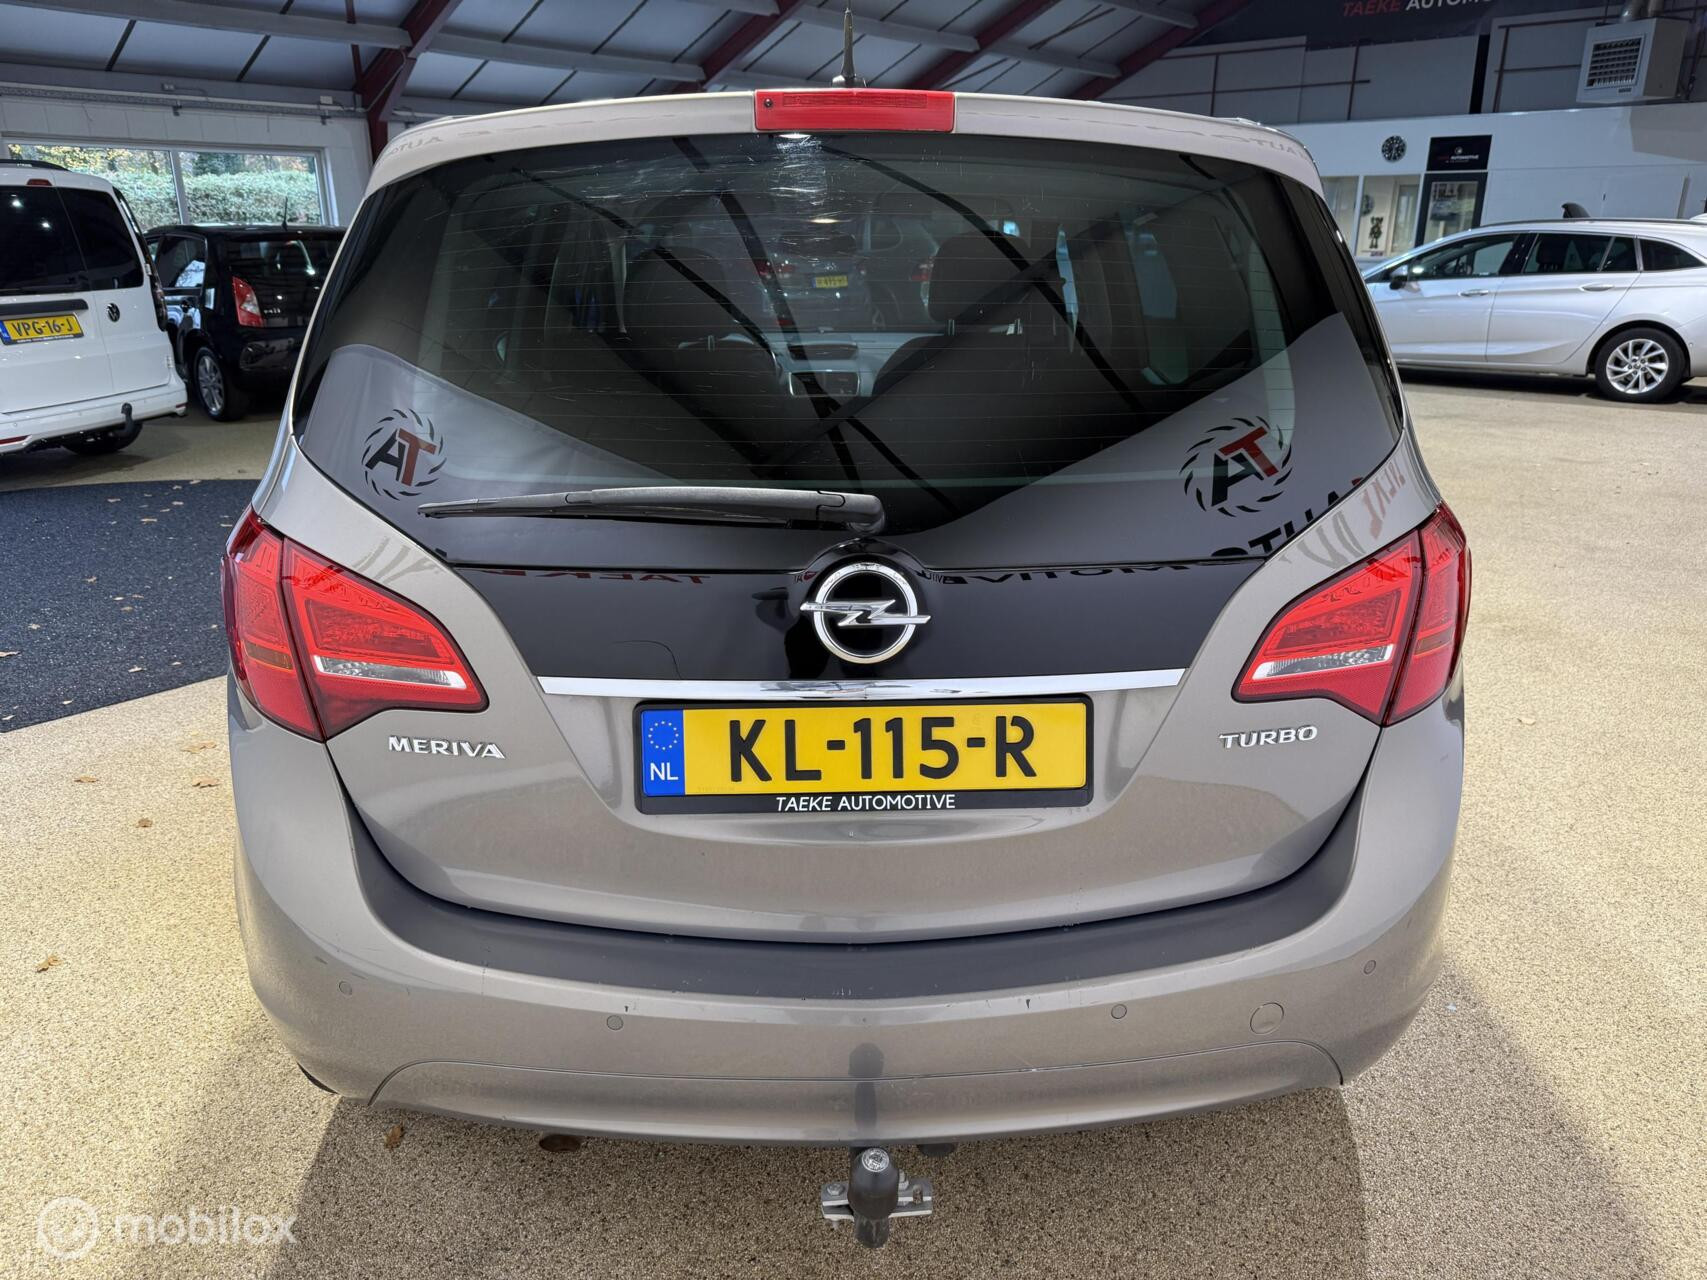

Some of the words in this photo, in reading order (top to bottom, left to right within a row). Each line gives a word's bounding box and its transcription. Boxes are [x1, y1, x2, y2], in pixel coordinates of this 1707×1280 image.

[1343, 0, 1400, 16] TAEKE
[1405, 0, 1491, 11] AUTO
[11, 318, 73, 336] VPG-16-J
[1218, 725, 1318, 749] TURBO
[388, 735, 505, 759] MERIVA
[729, 716, 1037, 782] KL-115-R
[650, 762, 679, 781] NL
[776, 796, 832, 811] TAEKE
[837, 794, 956, 811] AUTOMOTIVE
